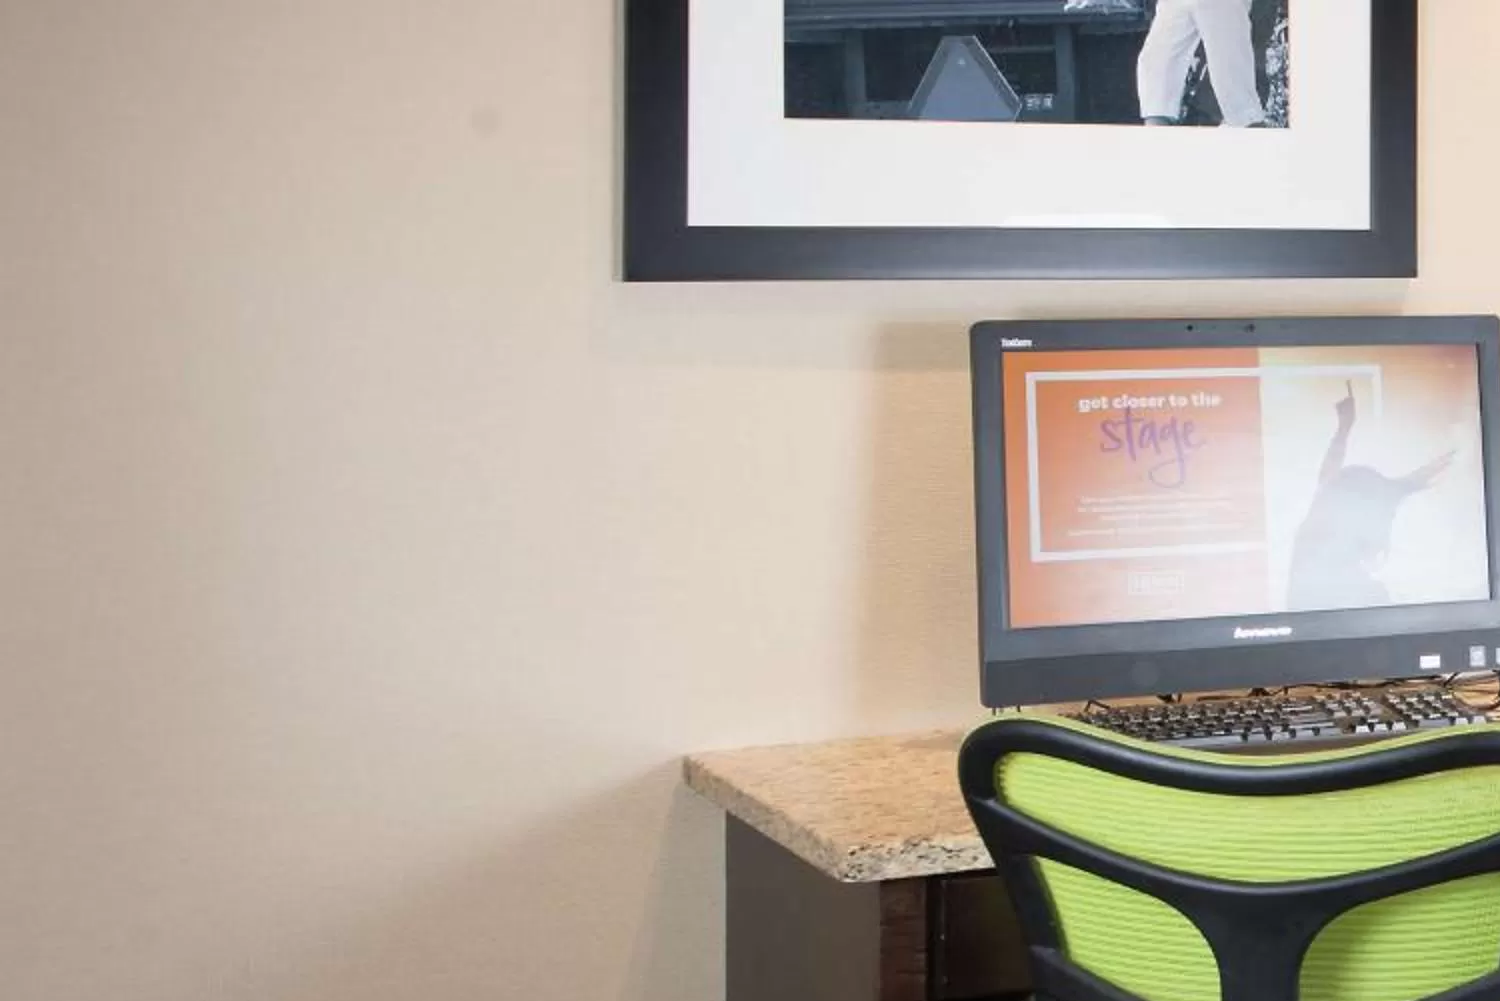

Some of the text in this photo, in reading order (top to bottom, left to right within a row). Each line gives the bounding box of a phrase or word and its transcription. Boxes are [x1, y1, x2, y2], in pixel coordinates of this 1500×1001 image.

[1078, 390, 1224, 413] get closer to the
[1101, 406, 1208, 488] stage
